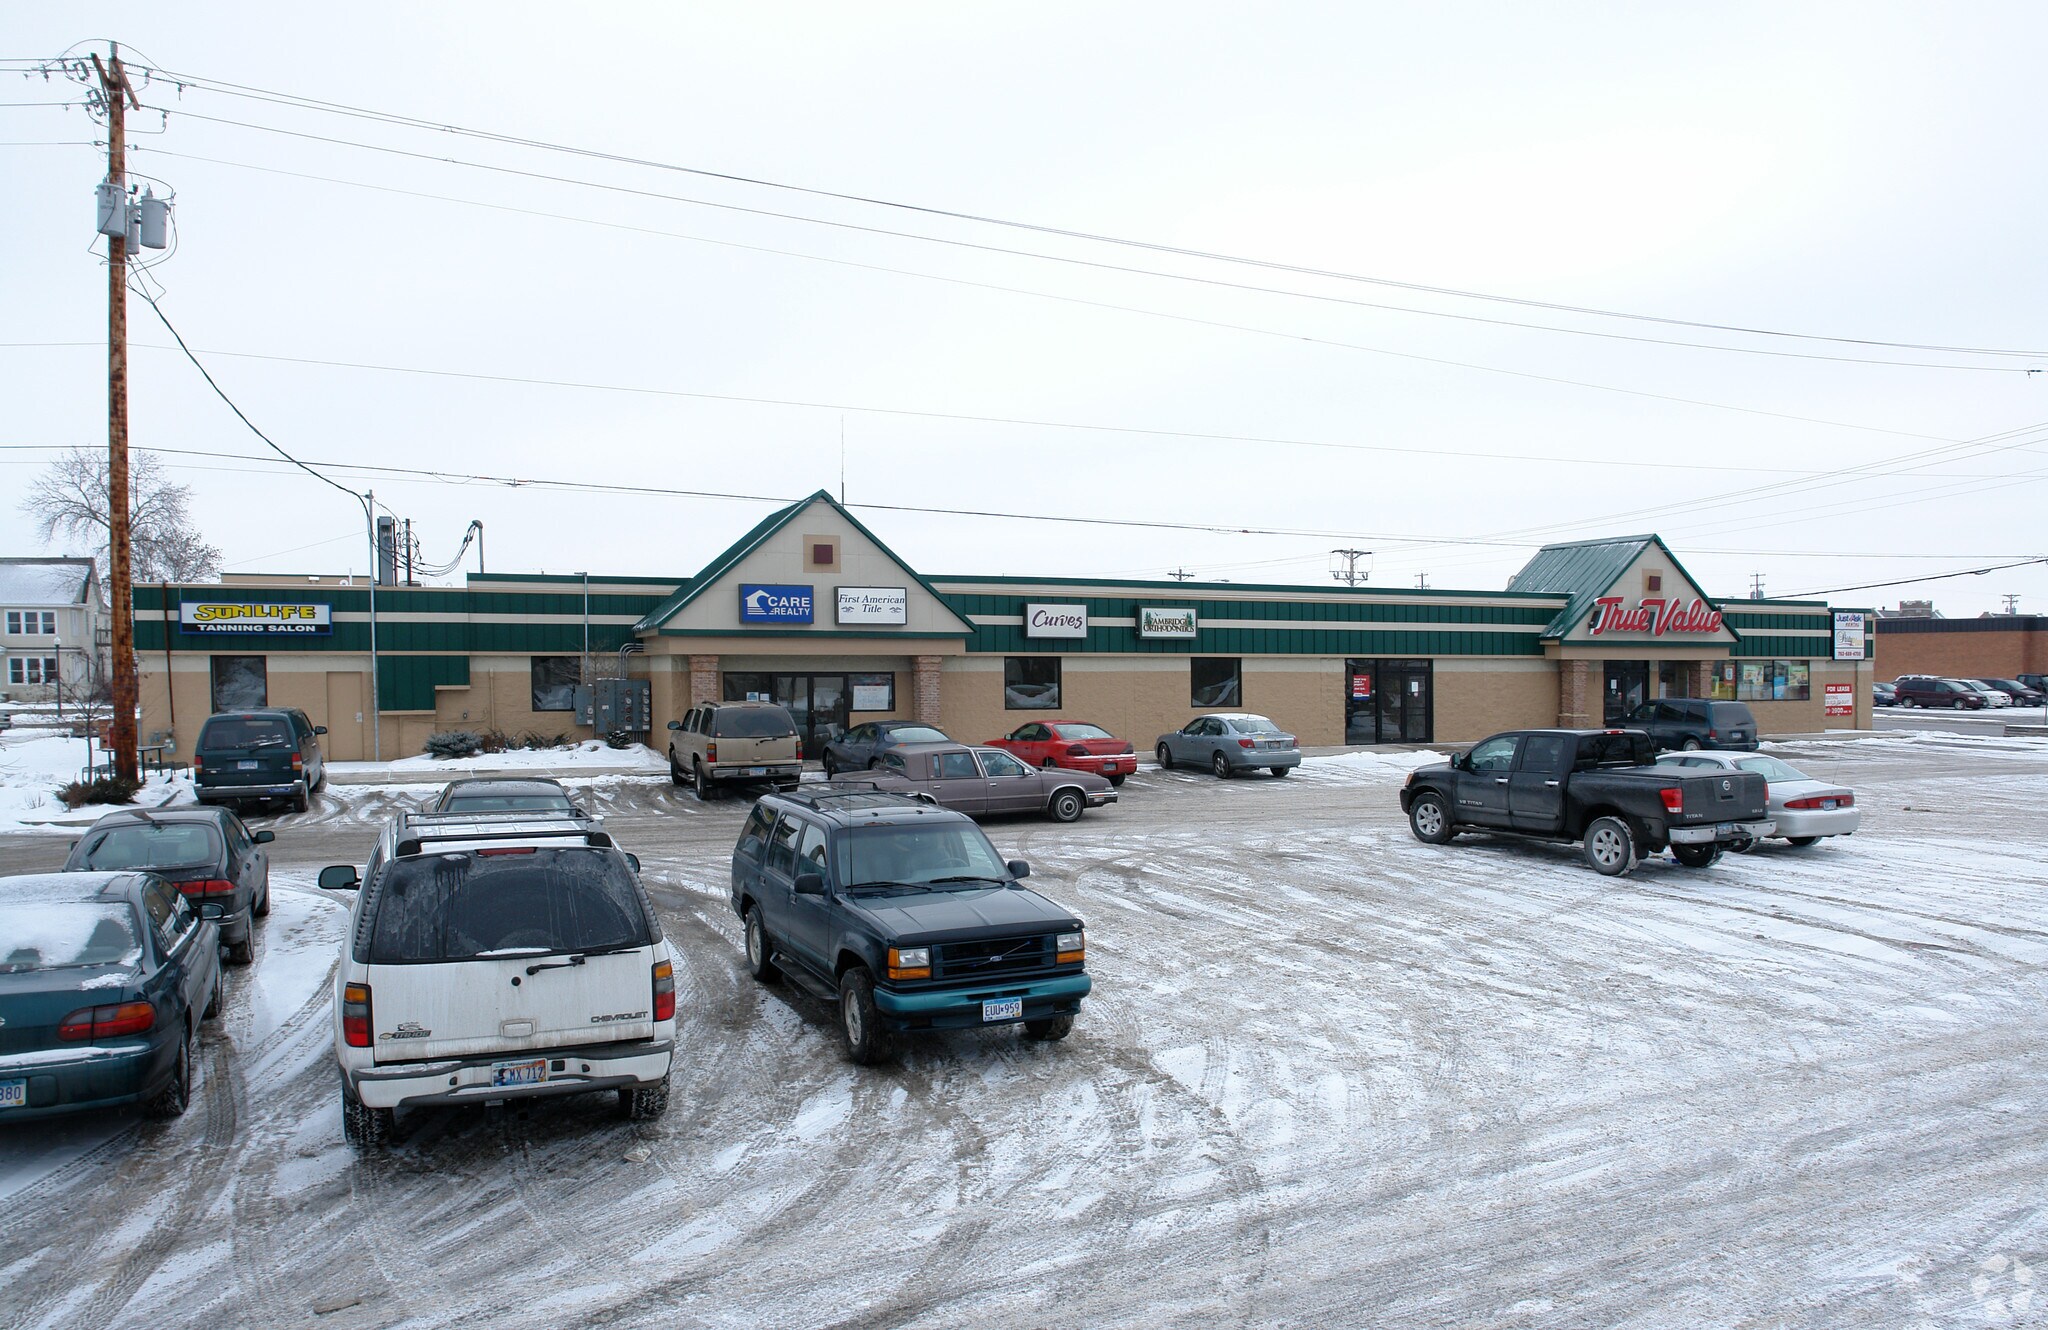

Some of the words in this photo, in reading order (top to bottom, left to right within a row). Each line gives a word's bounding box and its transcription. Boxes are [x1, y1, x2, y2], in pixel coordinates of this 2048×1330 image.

[767, 596, 811, 607] CARE
[839, 594, 860, 604] First
[861, 594, 905, 604] American
[193, 604, 317, 621] SUNLIFE
[773, 607, 811, 616] REALTY
[861, 604, 882, 613] Title
[1032, 610, 1083, 629] Curves
[1590, 596, 1650, 635] True
[1638, 598, 1722, 636] Value
[1836, 614, 1849, 622] Just
[197, 624, 264, 632] TANNING
[267, 624, 316, 632] SALON
[591, 1011, 648, 1023] CHEVROLET
